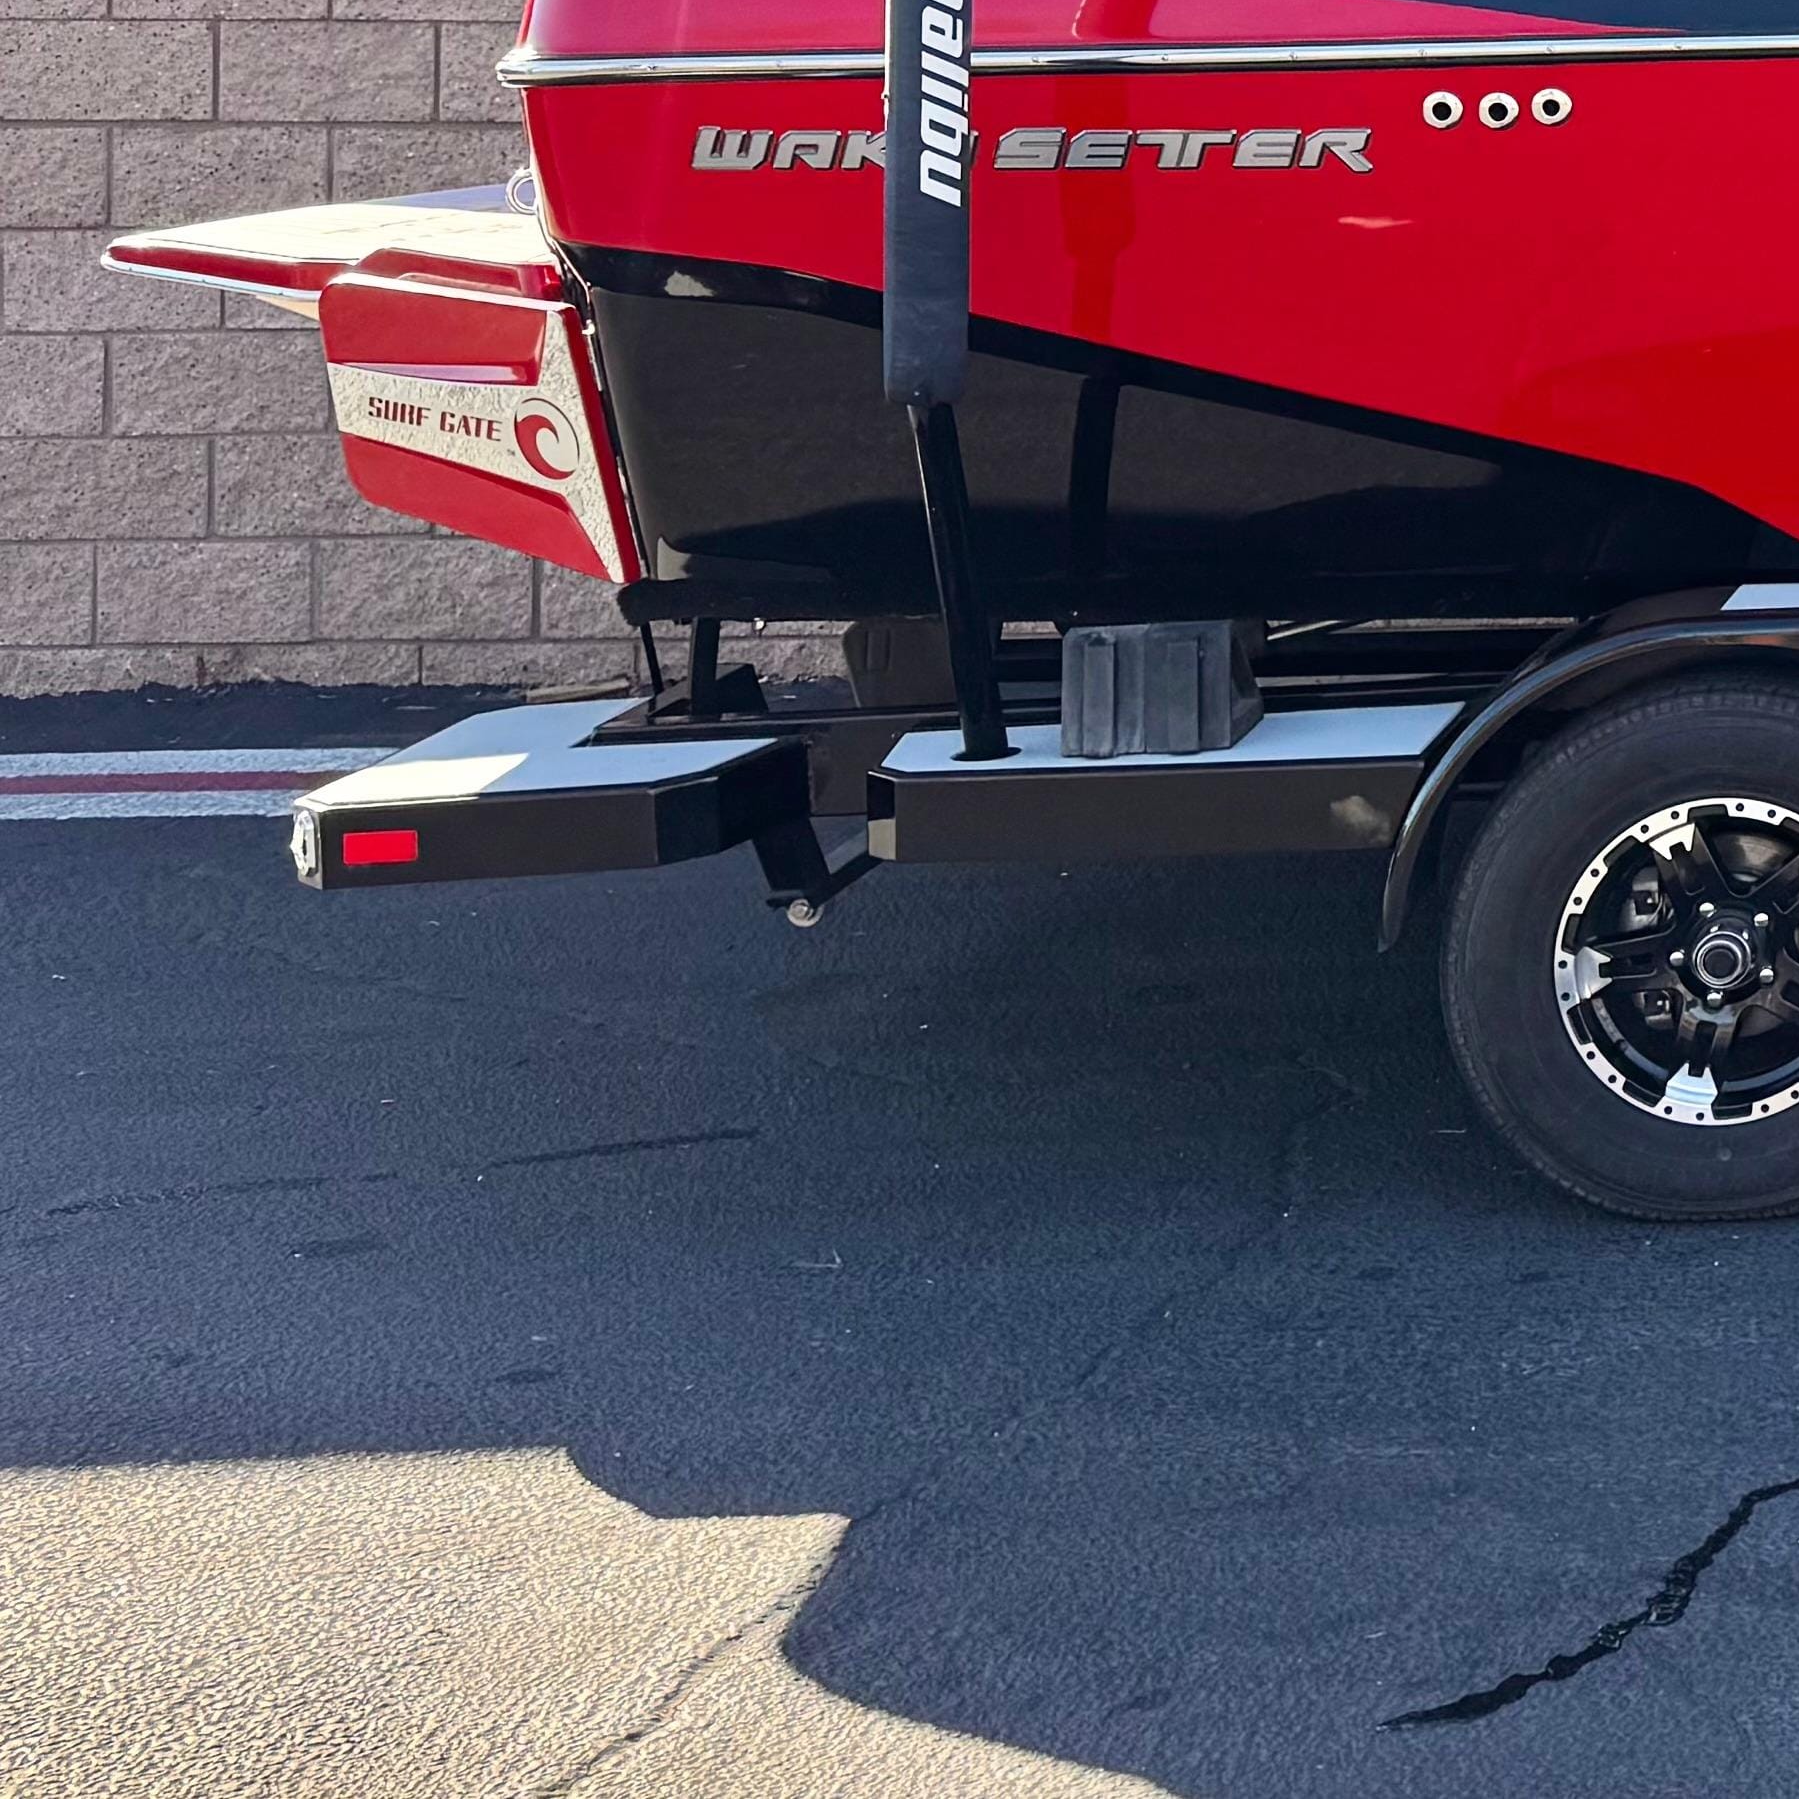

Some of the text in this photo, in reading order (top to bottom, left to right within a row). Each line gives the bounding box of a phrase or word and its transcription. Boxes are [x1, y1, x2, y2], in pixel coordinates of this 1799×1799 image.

[691, 125, 1374, 174] WAKSETTER
[368, 396, 503, 443] SURF GATE
